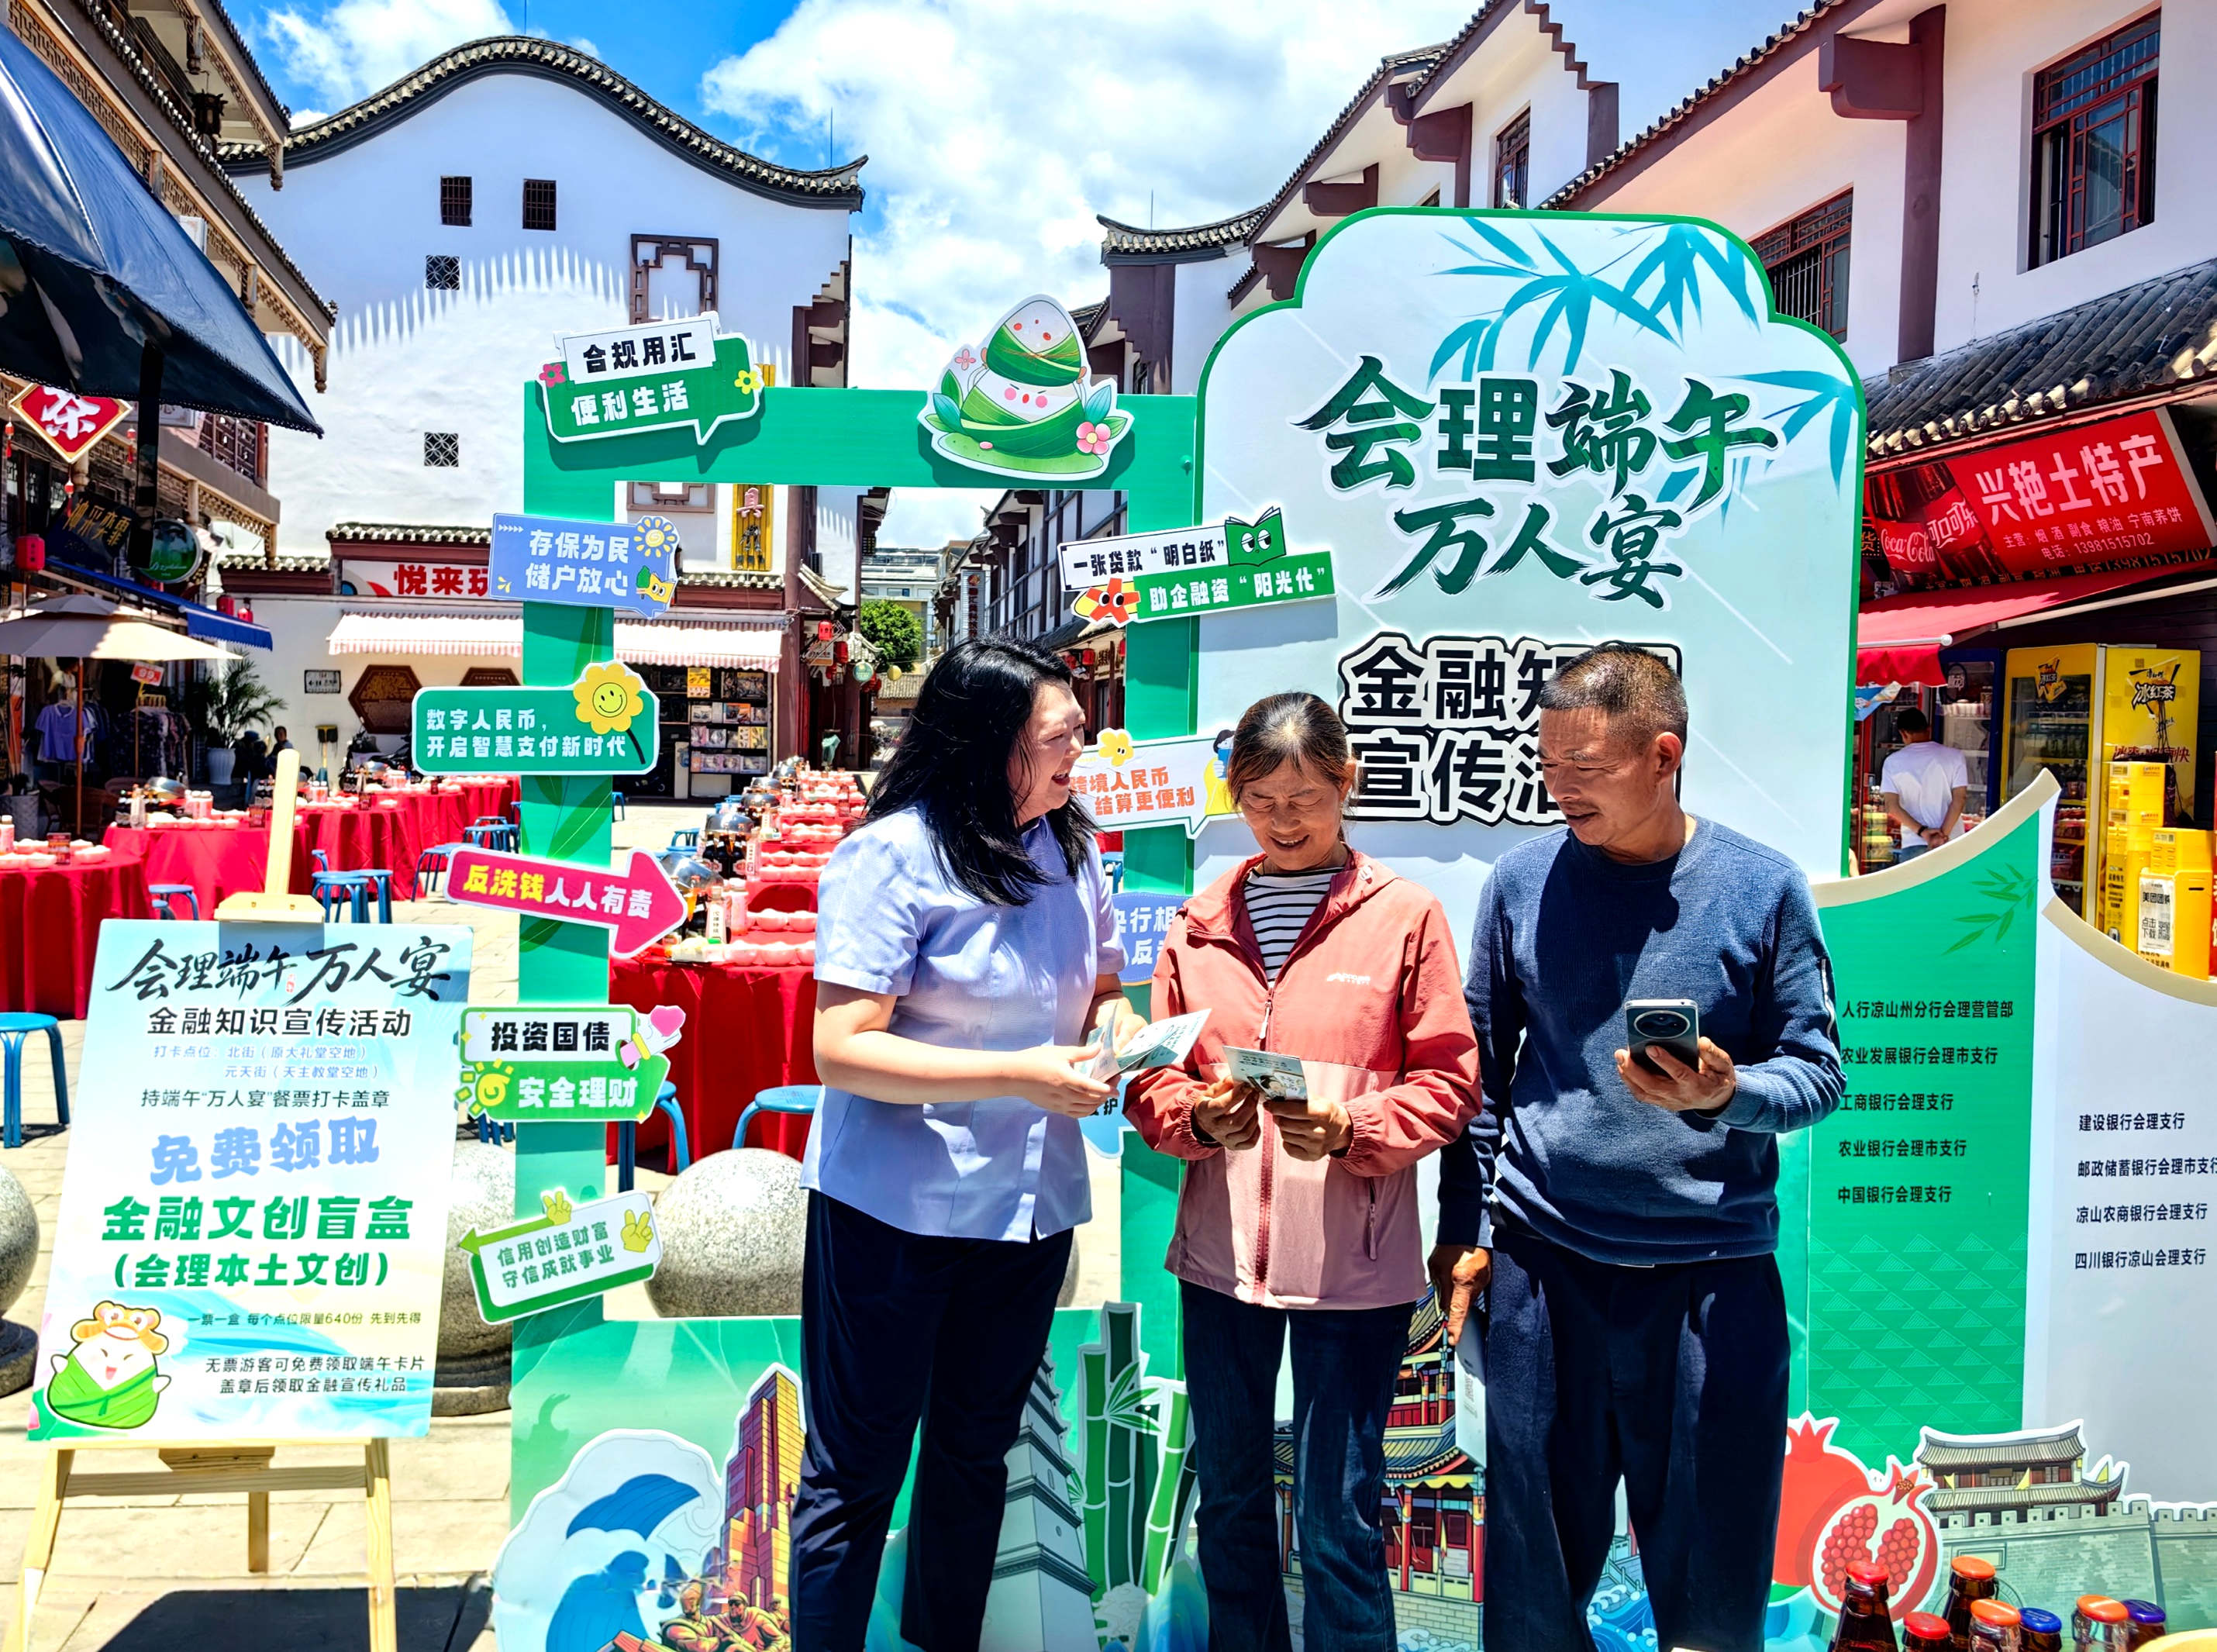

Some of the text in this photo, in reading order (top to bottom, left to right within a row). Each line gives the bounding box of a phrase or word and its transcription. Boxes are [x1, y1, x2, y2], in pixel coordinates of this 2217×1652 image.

[583, 332, 696, 374] 合规用汇
[571, 380, 688, 426] 便利生活
[1290, 355, 1778, 513] 会理端午
[1975, 433, 2164, 527] 兴艳土特产
[529, 529, 629, 564] 存保为民
[1373, 495, 1683, 609] 万人宴
[2074, 533, 2155, 554] 13981515702
[1073, 540, 1224, 577] 一张贷款“明白纸”
[526, 562, 629, 597] 储户放心
[2133, 682, 2175, 708] 冰红茶
[426, 709, 546, 731] 数字人民币，
[426, 736, 626, 758] 开启智慧支付新时代
[1070, 767, 1169, 795] 跨境人民币
[1095, 786, 1195, 816] 结算更便利
[463, 864, 653, 919] 反洗钱人人有责
[147, 1008, 412, 1037] 金融知识宣传活动
[1842, 1000, 2014, 1019] 人行凉山州分行会理营管部
[491, 1021, 610, 1052] 投资国债
[1840, 1047, 1998, 1066] 农业发展银行会理市支行
[141, 1088, 391, 1108] 持端午“万人宴”餐票打卡盖章
[518, 1077, 638, 1109] 安全理财
[1839, 1093, 1953, 1112] 工商银行会理支行
[2078, 1112, 2185, 1132] 建设银行会理支行
[150, 1116, 380, 1186] 免费领取
[1838, 1139, 1967, 1158] 农业银行会理市支行
[1838, 1186, 1952, 1205] 中国银行会理支行
[102, 1195, 413, 1241] 金融文创盲盒
[2076, 1202, 2208, 1224] 凉山农商银行会理支行
[497, 1221, 609, 1267] 信用创造财富
[114, 1252, 388, 1288] （会理本土文创）
[502, 1245, 615, 1288] 守信成就事业
[2075, 1248, 2206, 1270] 四川银行凉山会理支行
[247, 1312, 363, 1326] 每个点位限量640份
[370, 1312, 421, 1325] 先到先得
[205, 1356, 425, 1373] 无票游客可免费领取端午卡片
[219, 1377, 406, 1394] 盖章后领取金融宣传礼品
